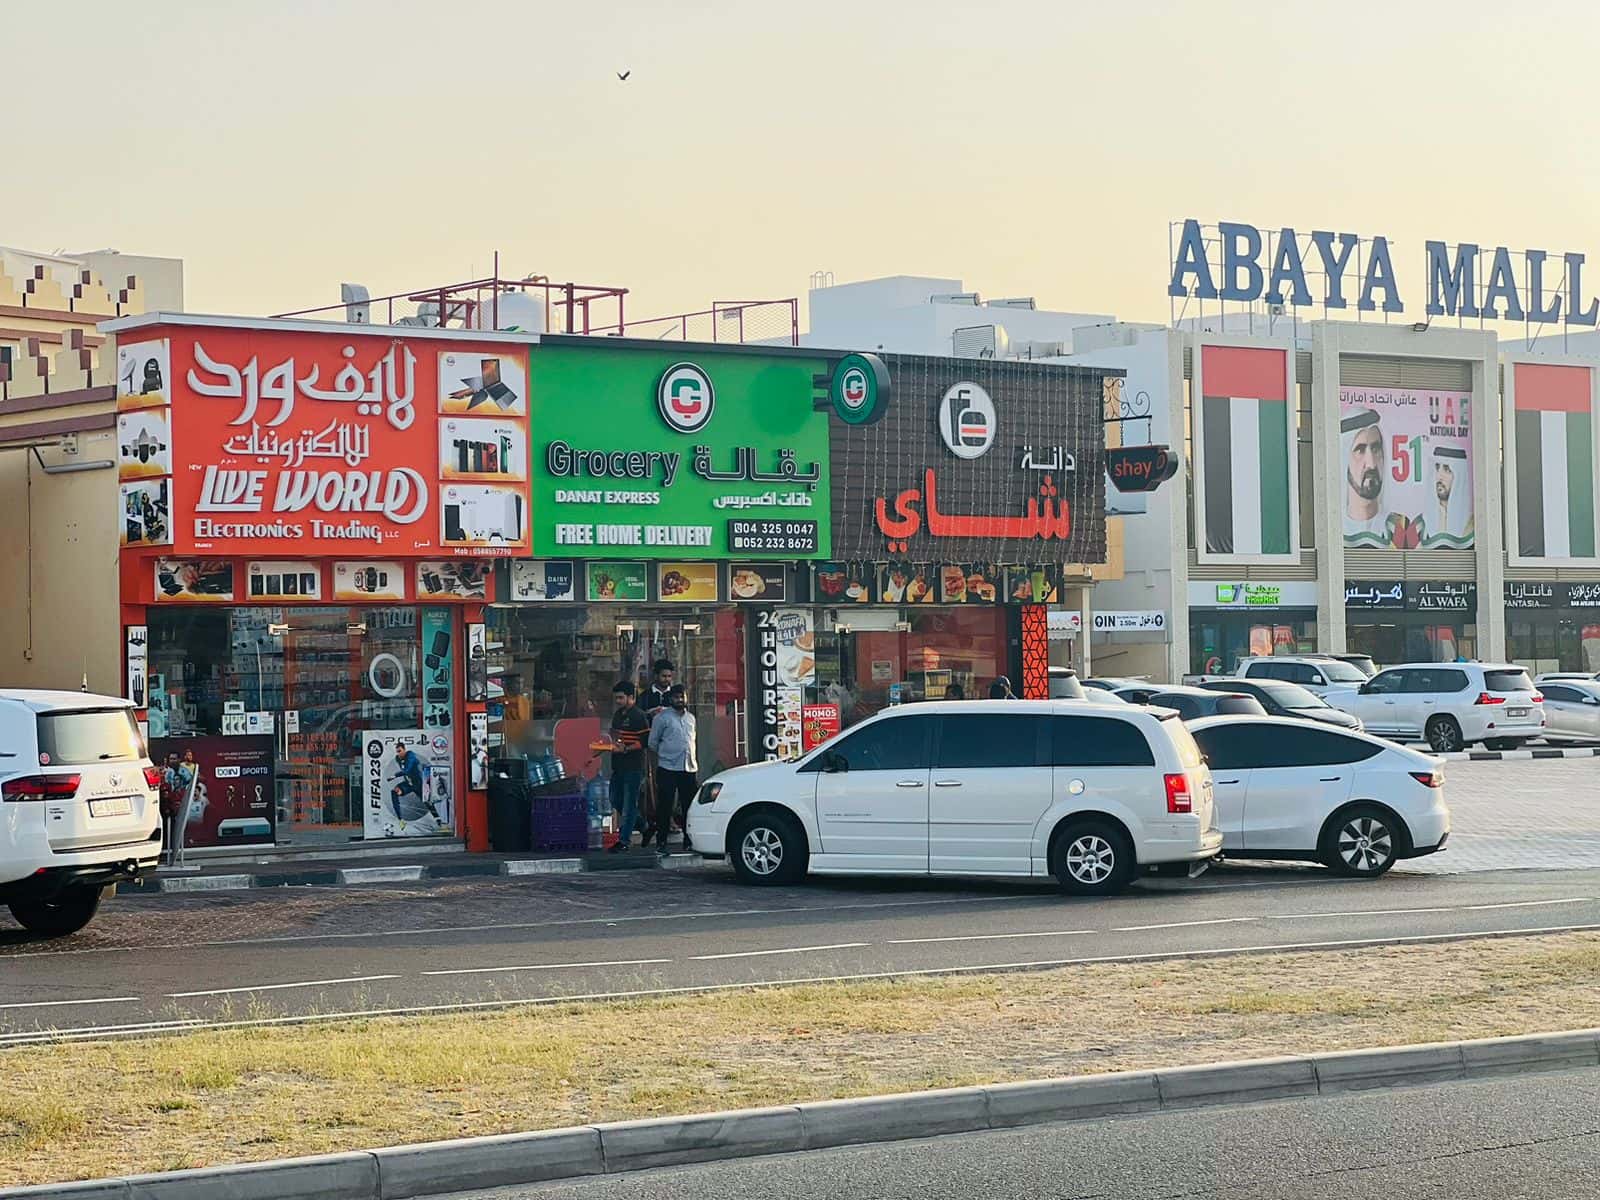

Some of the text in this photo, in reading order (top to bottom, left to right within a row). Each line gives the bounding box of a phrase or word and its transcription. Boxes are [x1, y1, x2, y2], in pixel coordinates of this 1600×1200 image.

[1168, 219, 1599, 326] ABAYA MALL
[1429, 397, 1468, 425] UAE
[549, 439, 681, 487] Grocery
[695, 445, 820, 491] بقالة
[1021, 445, 1075, 470] دانة
[1114, 457, 1152, 479] shay
[195, 465, 428, 524] LIVE WORLD
[555, 490, 660, 504] DANAT EXPRESS
[876, 467, 1070, 553] شاي
[385, 530, 400, 538] LLC
[556, 524, 712, 546] FREE HOME DELIVERY
[743, 523, 814, 535] 04 325 0047
[743, 537, 813, 549] 052 232 8672
[1419, 597, 1434, 607] AL
[1436, 597, 1468, 607] WAFA
[757, 611, 778, 628] 24
[1104, 615, 1116, 627] IN
[761, 631, 777, 725] HOURS
[803, 709, 837, 718] MOMOS
[242, 766, 268, 775] SPORTS
